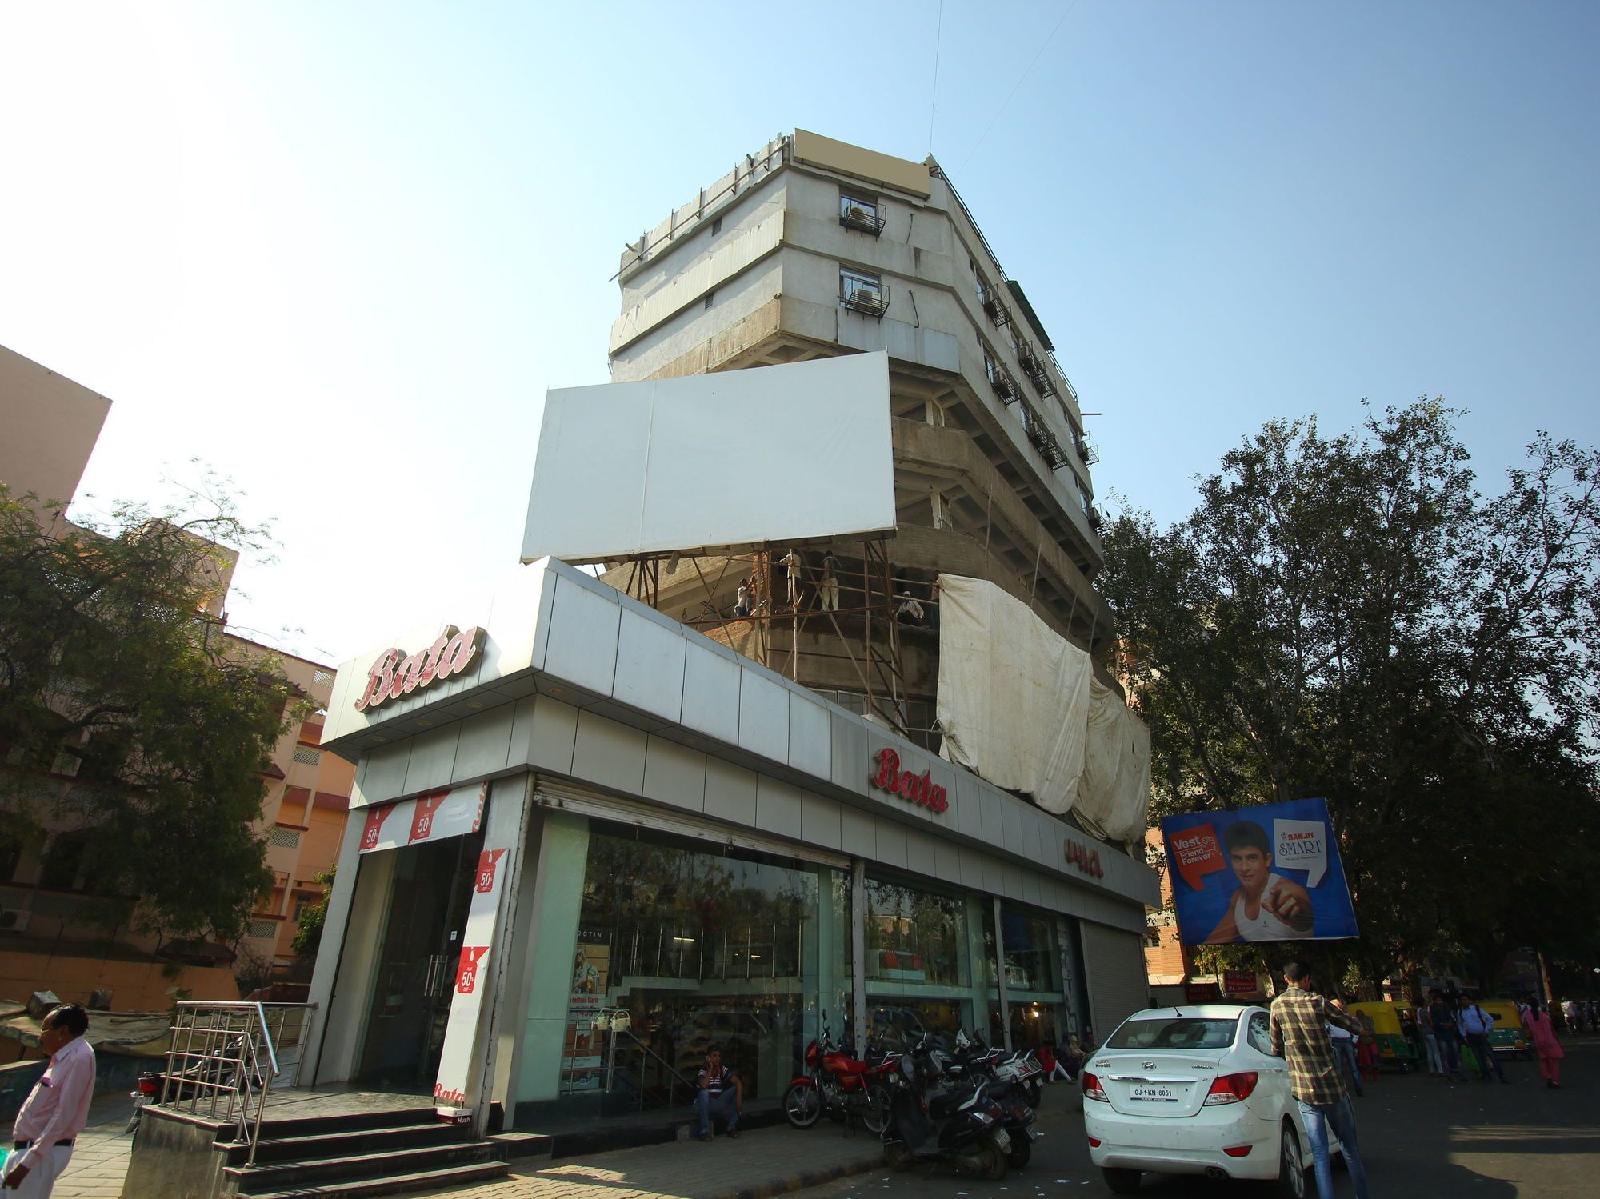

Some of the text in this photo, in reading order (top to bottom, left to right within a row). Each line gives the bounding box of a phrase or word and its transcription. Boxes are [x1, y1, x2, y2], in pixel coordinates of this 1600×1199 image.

[354, 624, 487, 713] Bata
[872, 747, 949, 814] Bata
[1174, 836, 1201, 850] Vest
[1279, 840, 1320, 857] SMART
